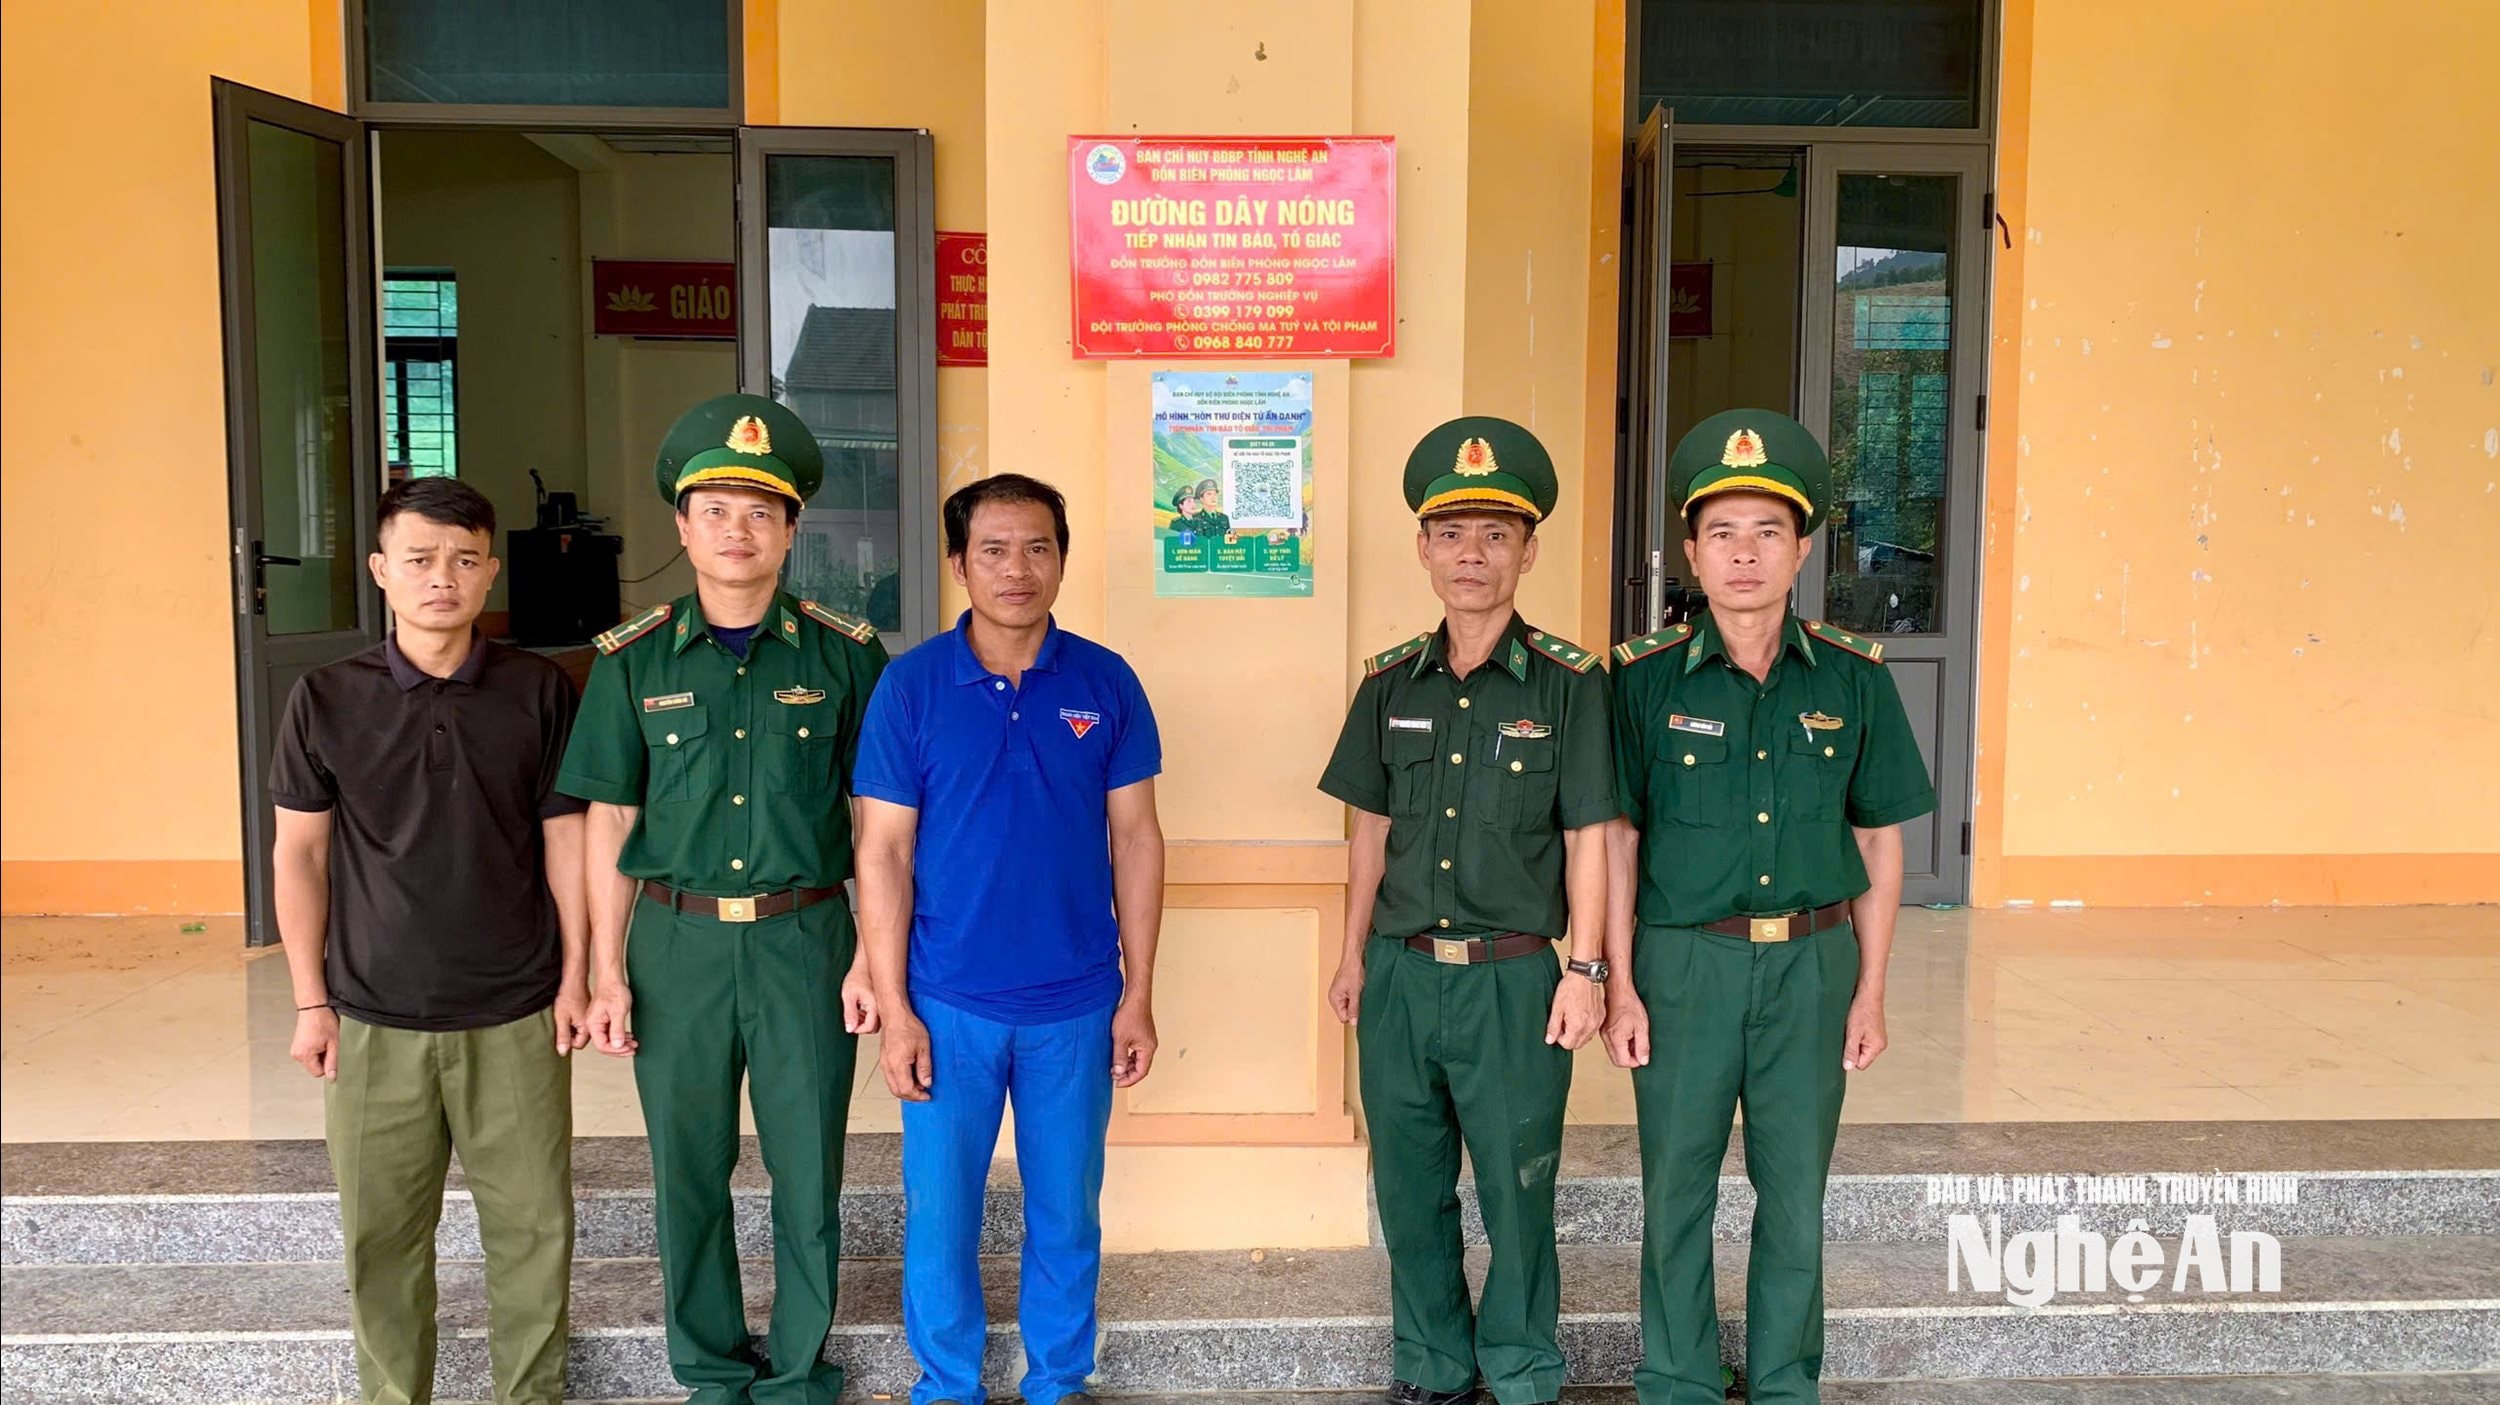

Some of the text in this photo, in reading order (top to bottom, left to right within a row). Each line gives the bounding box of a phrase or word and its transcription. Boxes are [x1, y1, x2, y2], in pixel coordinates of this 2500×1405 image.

[1136, 150, 1161, 164] BAN
[1187, 150, 1209, 164] HUY
[1311, 150, 1328, 164] AN
[1180, 165, 1207, 182] BIÊN
[1210, 165, 1249, 182] PHÒNG
[1253, 168, 1285, 185] NGỌC
[1288, 165, 1313, 182] LÂM
[1111, 193, 1354, 226] ĐƯỜNG DÂY NÓNG
[1125, 227, 1342, 251] TIẾP NHẬN TIN BÁO, TỐ GIÁC
[1110, 254, 1137, 268] ĐỒN
[1191, 255, 1217, 268] ĐỒN
[1220, 255, 1245, 268] BIÊN
[1248, 255, 1290, 268] PHÒNG
[1294, 258, 1329, 271] NGỌC
[1333, 255, 1356, 268] LÂM
[950, 275, 976, 296] THỰC
[1193, 273, 1294, 286] 0982 775 809
[671, 278, 731, 319] GIÁO
[1150, 289, 1175, 301] PHÓ
[1178, 288, 1204, 301] ĐỒN
[1258, 289, 1300, 303] NGHIỆP
[1303, 291, 1318, 304] VỤ
[941, 300, 966, 319] PHÁT
[1193, 305, 1294, 318] 0399 179 099
[1091, 320, 1112, 335] ĐỘI
[1166, 320, 1208, 332] PHÒNG
[1212, 319, 1255, 332] CHỐNG
[1259, 322, 1276, 332] MA
[1303, 320, 1320, 332] VÀ
[1322, 320, 1341, 334] TỘI
[1344, 321, 1377, 334] PHẠM
[953, 327, 974, 348] DÂN
[1194, 336, 1294, 349] 0968 840 777
[1156, 411, 1168, 420] MÔ
[1170, 411, 1189, 420] HÌNH
[1214, 411, 1231, 420] THƯ
[1232, 411, 1251, 423] ĐIỆN
